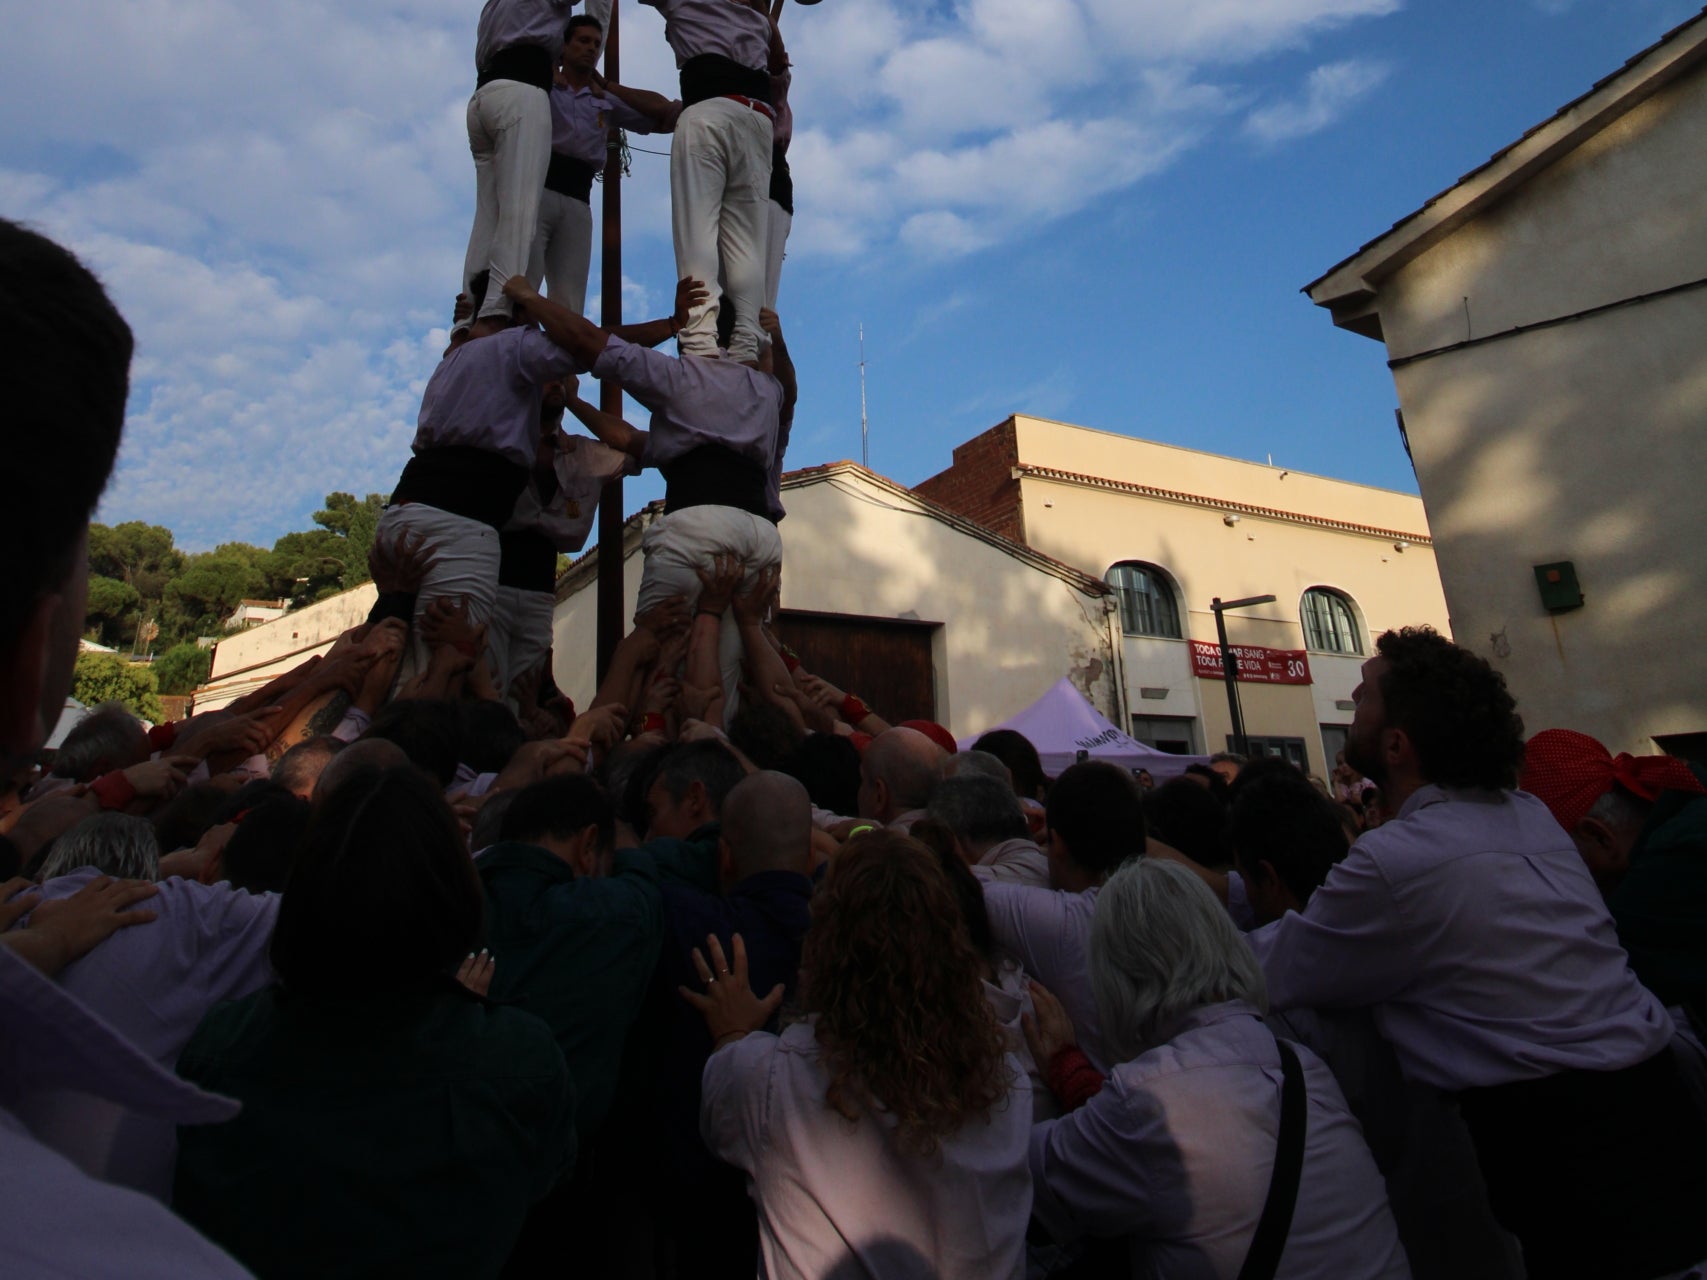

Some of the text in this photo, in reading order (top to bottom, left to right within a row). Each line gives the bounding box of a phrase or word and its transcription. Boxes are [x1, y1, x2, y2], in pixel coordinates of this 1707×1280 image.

[1194, 644, 1216, 656] TOCA
[1244, 648, 1264, 659] SANG
[1196, 656, 1217, 667] TOCA
[1244, 660, 1261, 670] VIDA
[1288, 660, 1305, 677] 30
